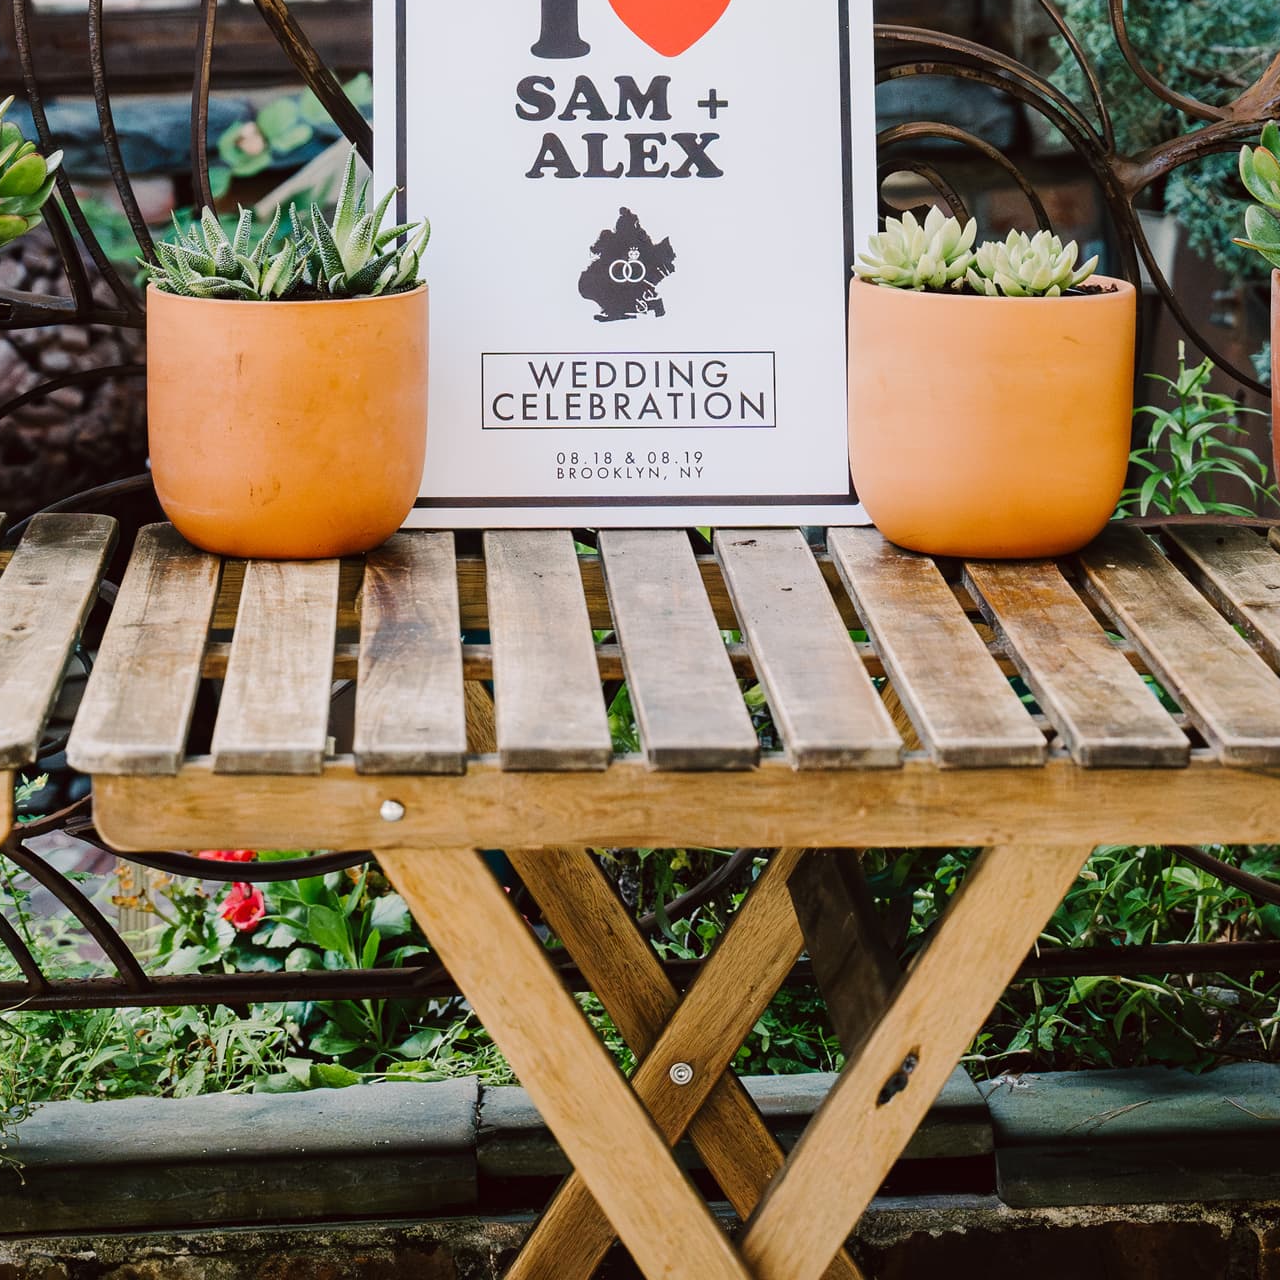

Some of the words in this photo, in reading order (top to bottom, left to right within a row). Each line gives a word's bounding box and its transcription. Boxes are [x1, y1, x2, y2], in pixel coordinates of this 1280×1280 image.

[516, 75, 672, 121] SAM
[698, 89, 728, 119] +
[525, 132, 724, 179] ALEX
[528, 360, 728, 389] WEDDING
[492, 391, 765, 421] CELEBRATION
[556, 451, 613, 465] 08.18
[624, 451, 636, 465] &
[647, 451, 703, 465] 08.19
[556, 466, 667, 481] BROOKLYN,
[680, 466, 704, 479] NY
